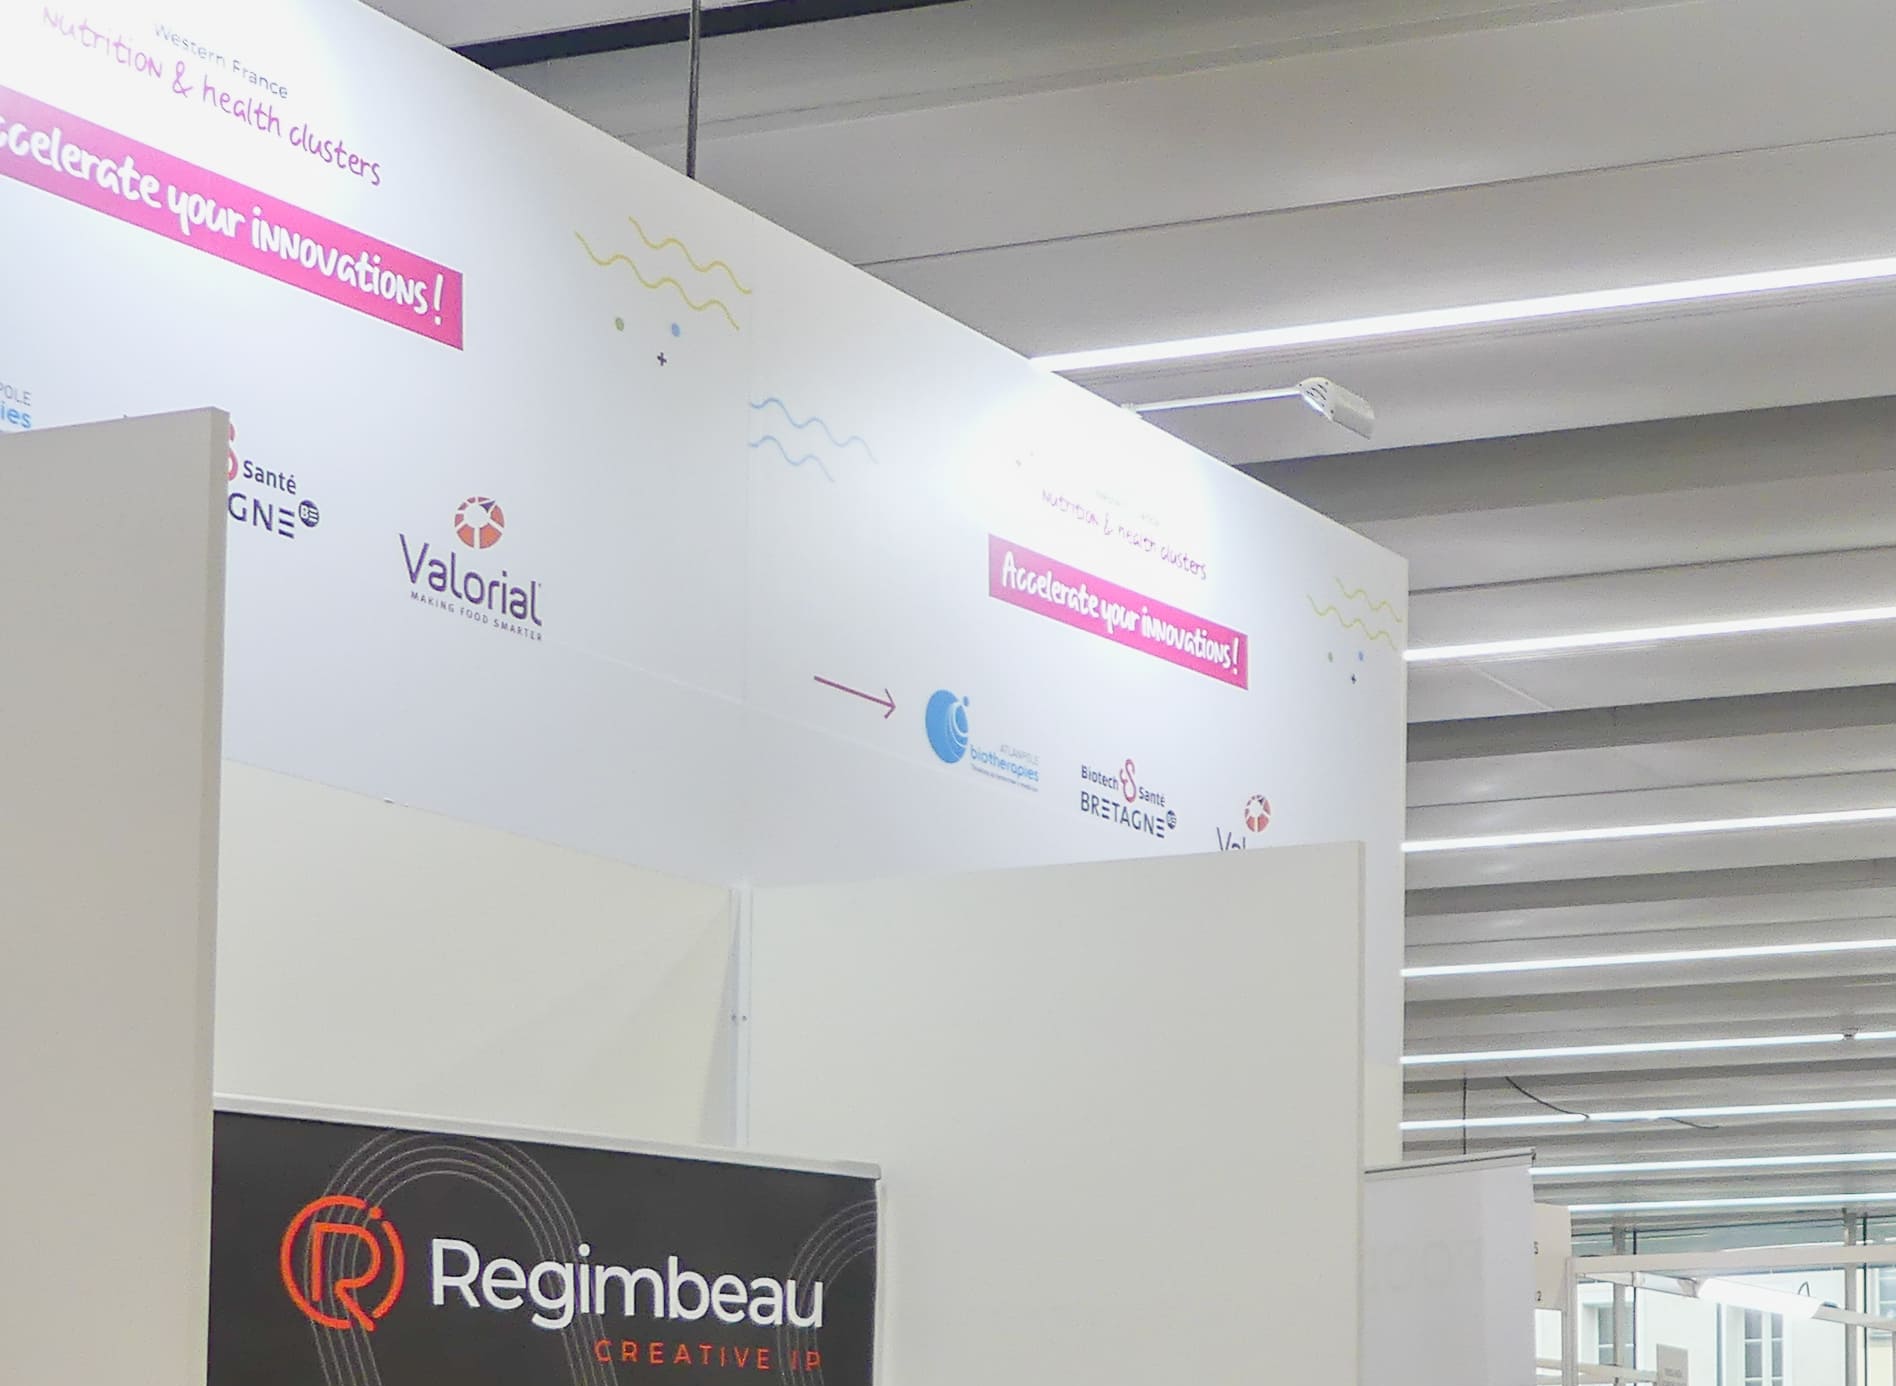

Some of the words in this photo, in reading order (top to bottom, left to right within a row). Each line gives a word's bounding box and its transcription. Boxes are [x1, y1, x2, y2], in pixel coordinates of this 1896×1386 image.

[155, 22, 226, 68] Western
[233, 60, 288, 99] France
[43, 6, 163, 79] Nutrition
[172, 61, 193, 97] &
[202, 74, 281, 137] health
[289, 123, 381, 186] clusters
[167, 184, 245, 236] your
[243, 460, 297, 495] Santé
[227, 493, 295, 539] GNE
[399, 533, 542, 626] Valorial
[1002, 551, 1100, 617] Accelerate
[1101, 599, 1140, 634] your
[410, 590, 455, 613] MAKING
[460, 607, 489, 624] FOOD
[493, 618, 542, 641] SMARTER
[1081, 765, 1119, 791] Biotech
[1081, 791, 1165, 838] BRETAGNE
[430, 1238, 825, 1330] Regimbeau
[594, 1339, 771, 1370] CREATIVE
[790, 1350, 822, 1371] IP
